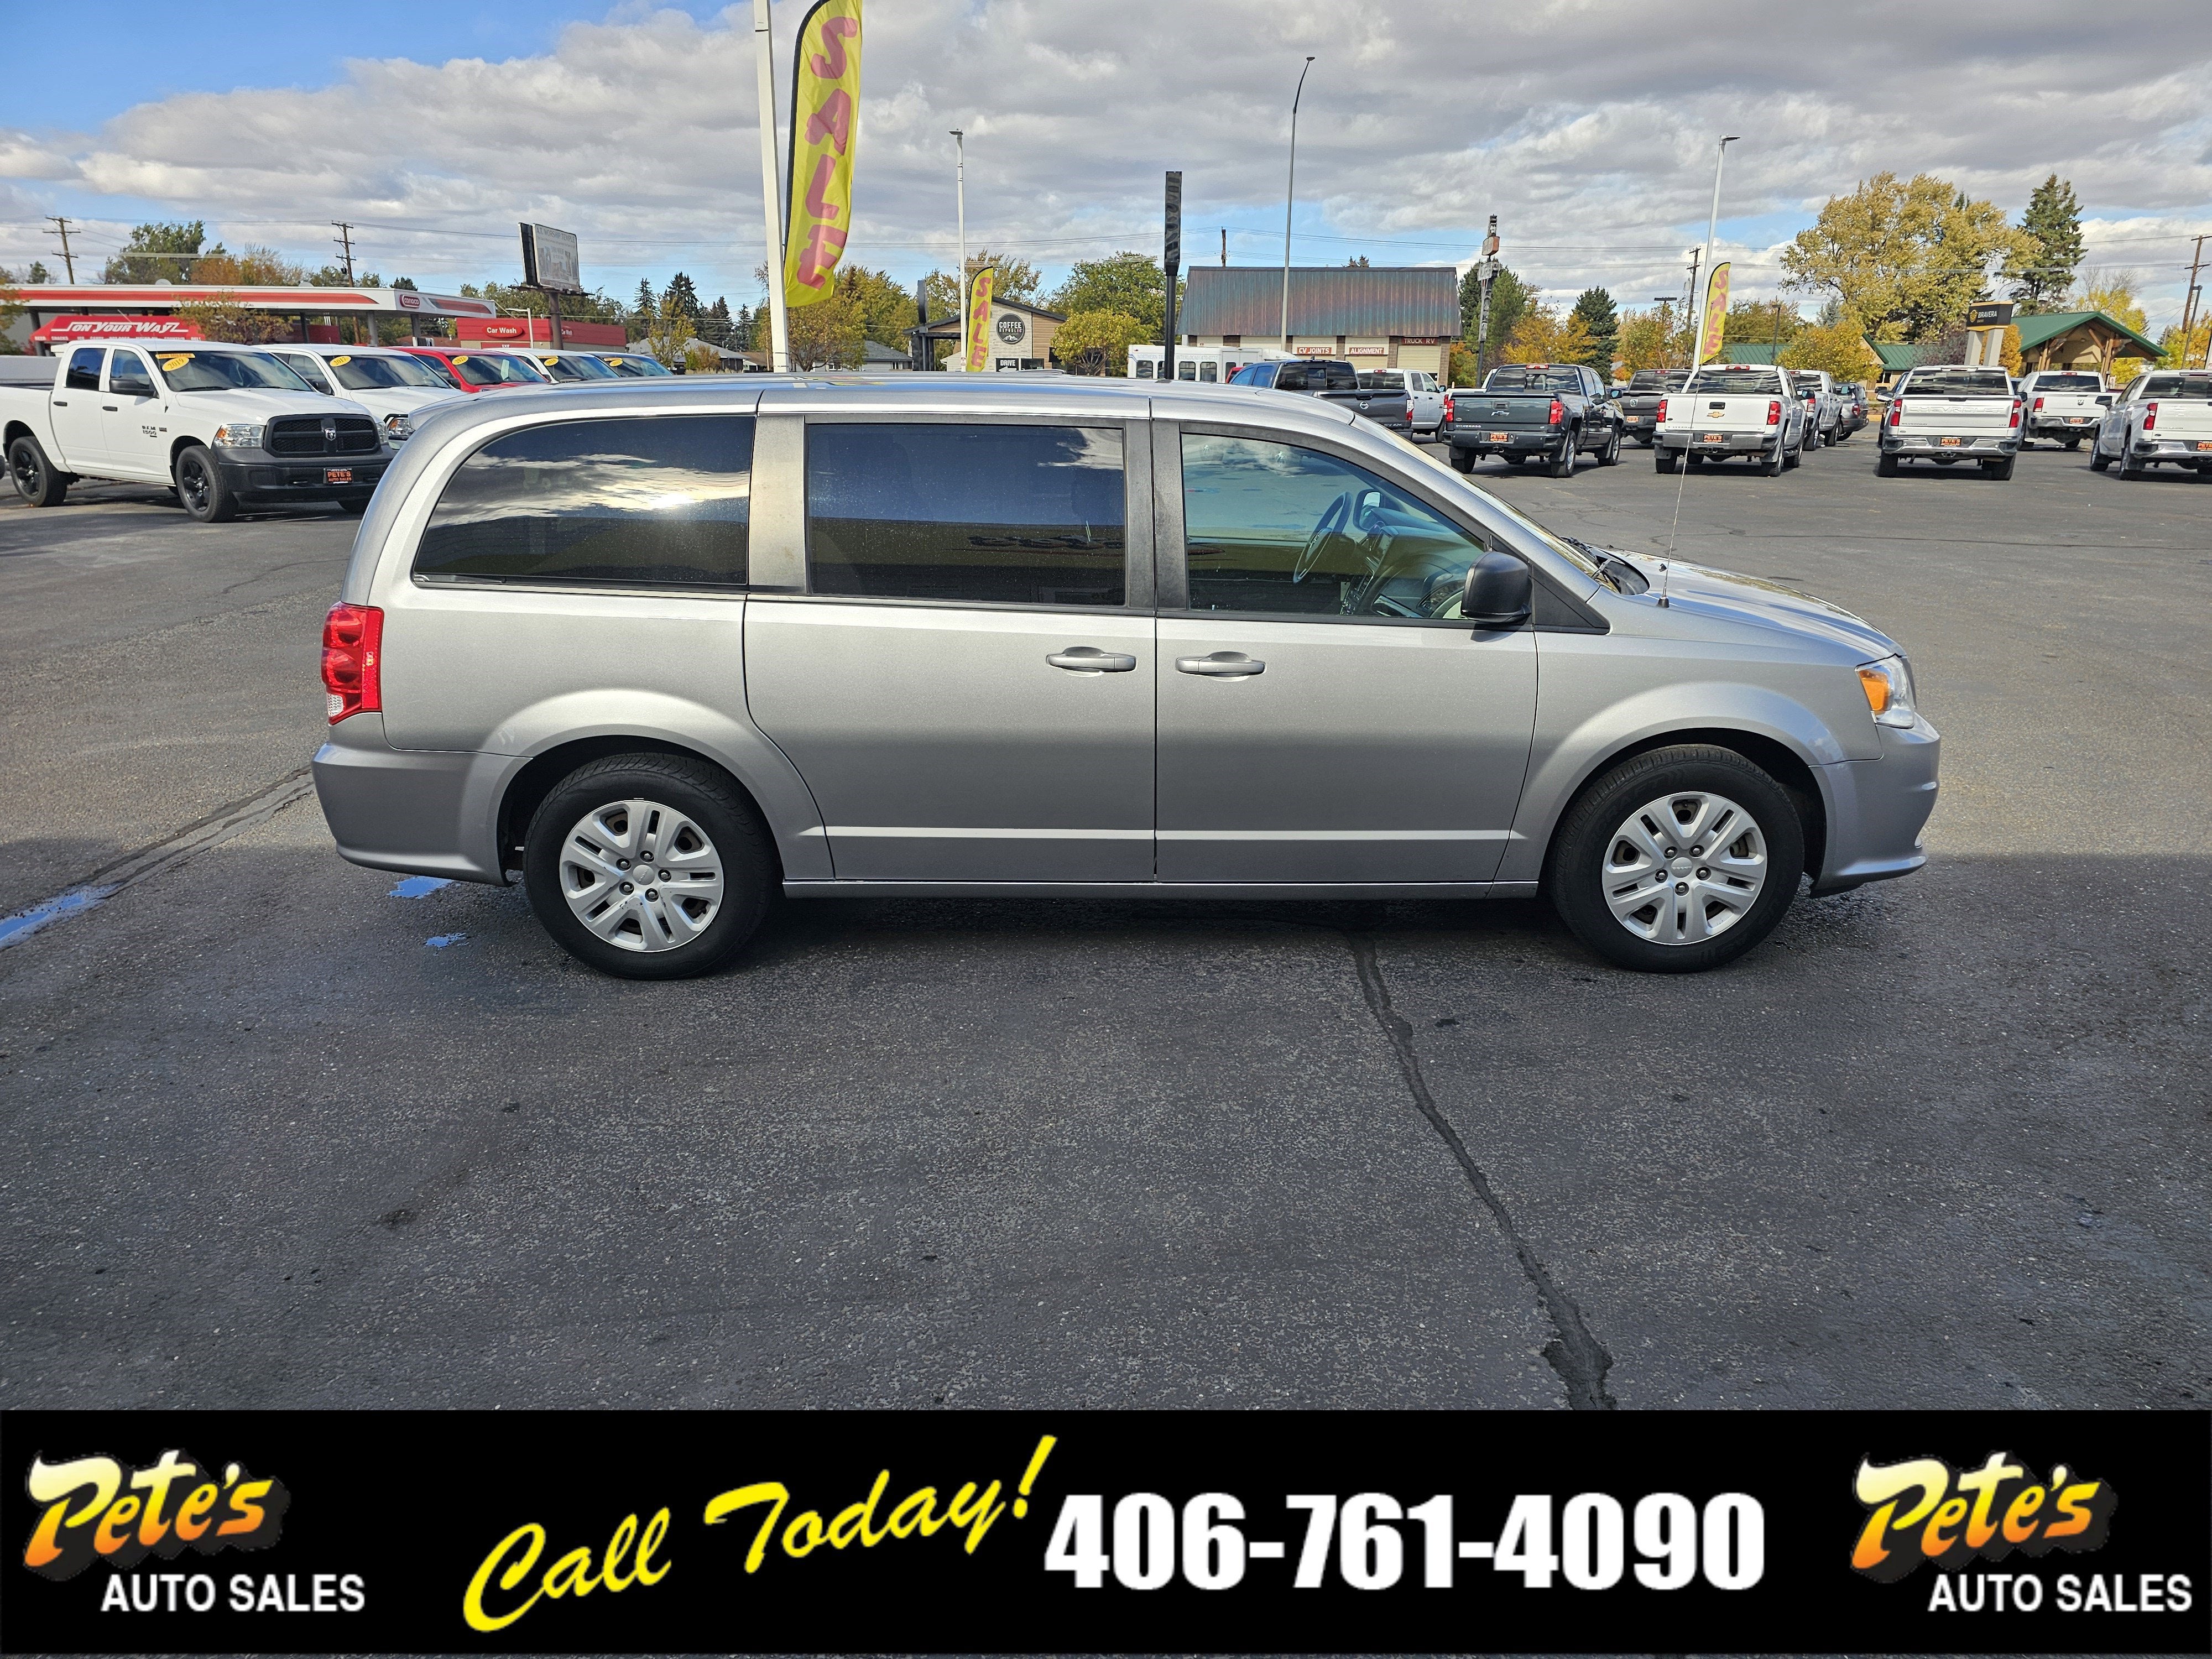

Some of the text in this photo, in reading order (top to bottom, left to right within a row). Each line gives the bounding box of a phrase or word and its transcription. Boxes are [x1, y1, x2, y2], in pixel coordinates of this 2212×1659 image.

[797, 16, 858, 290] SALE
[971, 277, 991, 368] SALE
[1704, 270, 1729, 355] SALE
[168, 358, 184, 369] 2019
